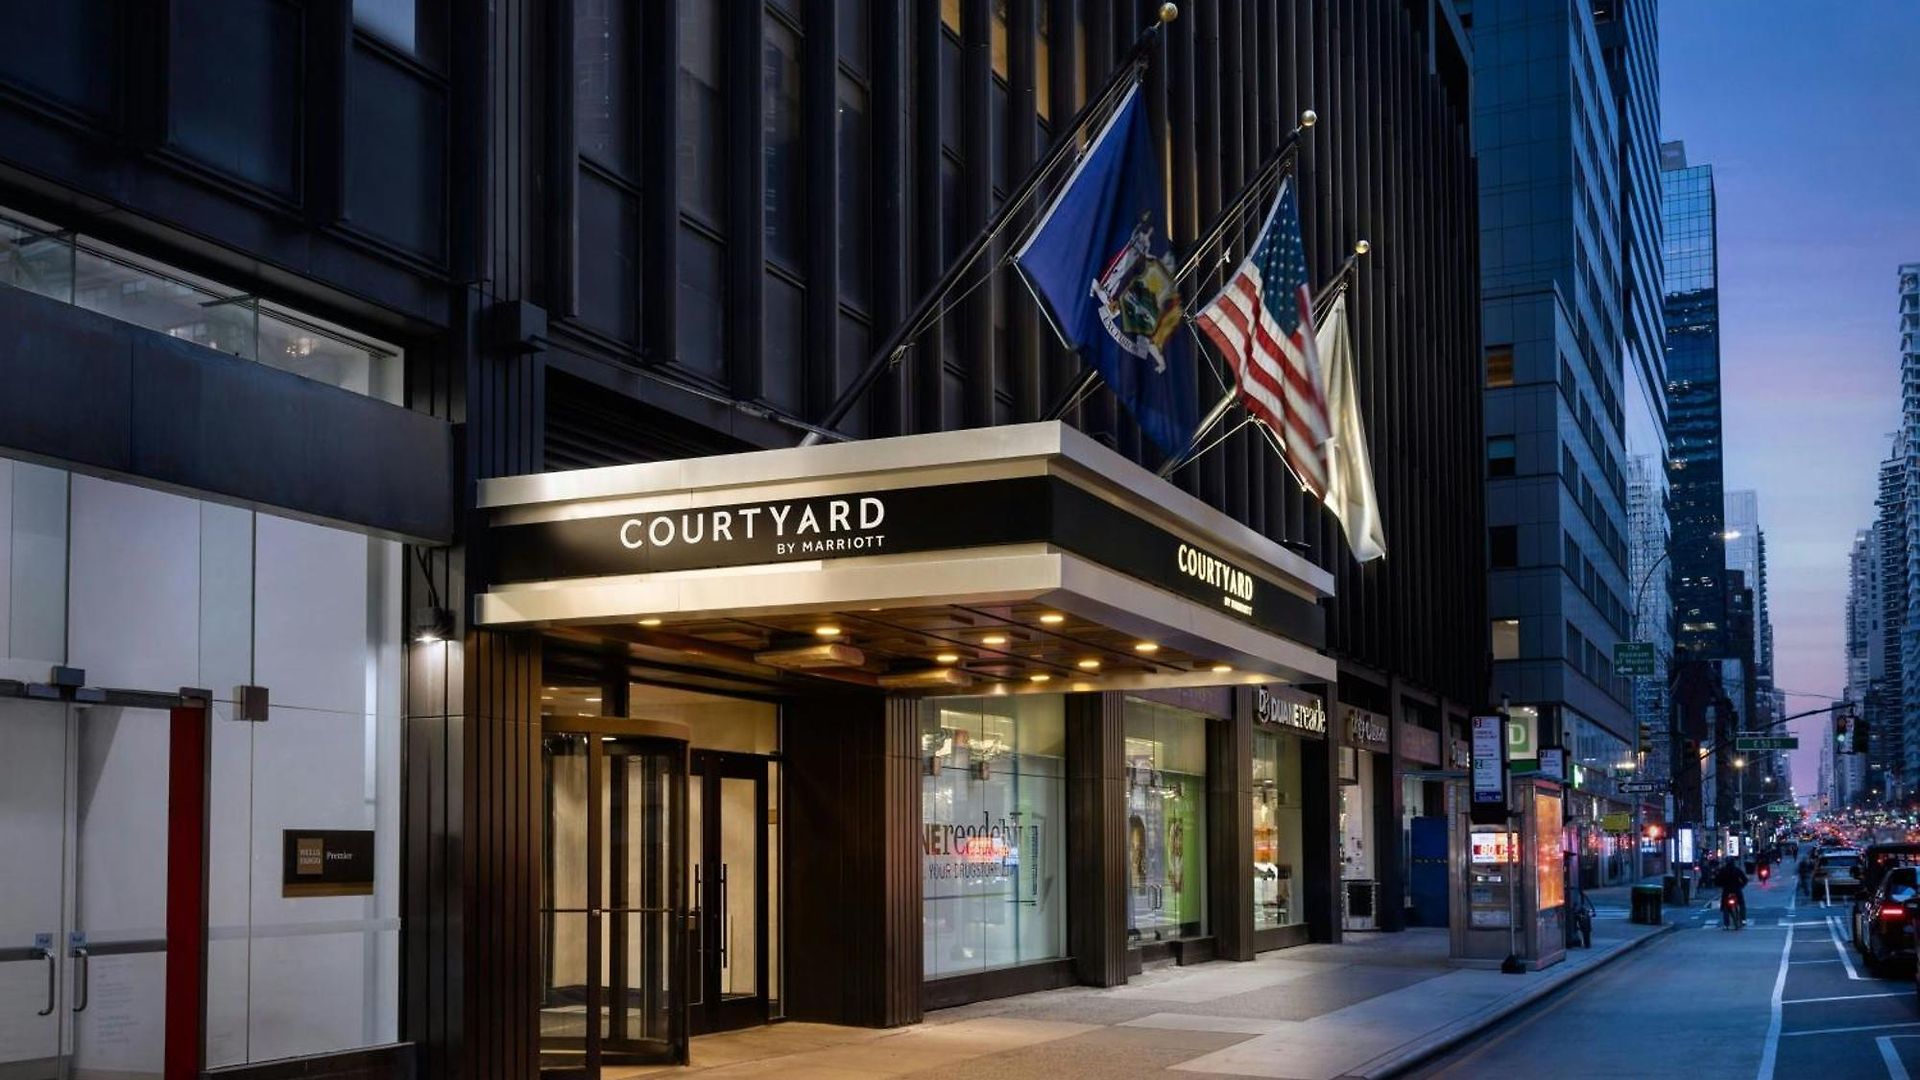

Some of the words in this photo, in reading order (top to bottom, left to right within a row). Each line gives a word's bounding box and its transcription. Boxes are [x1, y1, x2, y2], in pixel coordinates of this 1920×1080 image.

[620, 498, 885, 549] COURTYARD
[777, 543, 796, 555] BY
[802, 536, 886, 553] MARRIOTT
[1178, 544, 1253, 601] COURTYARD
